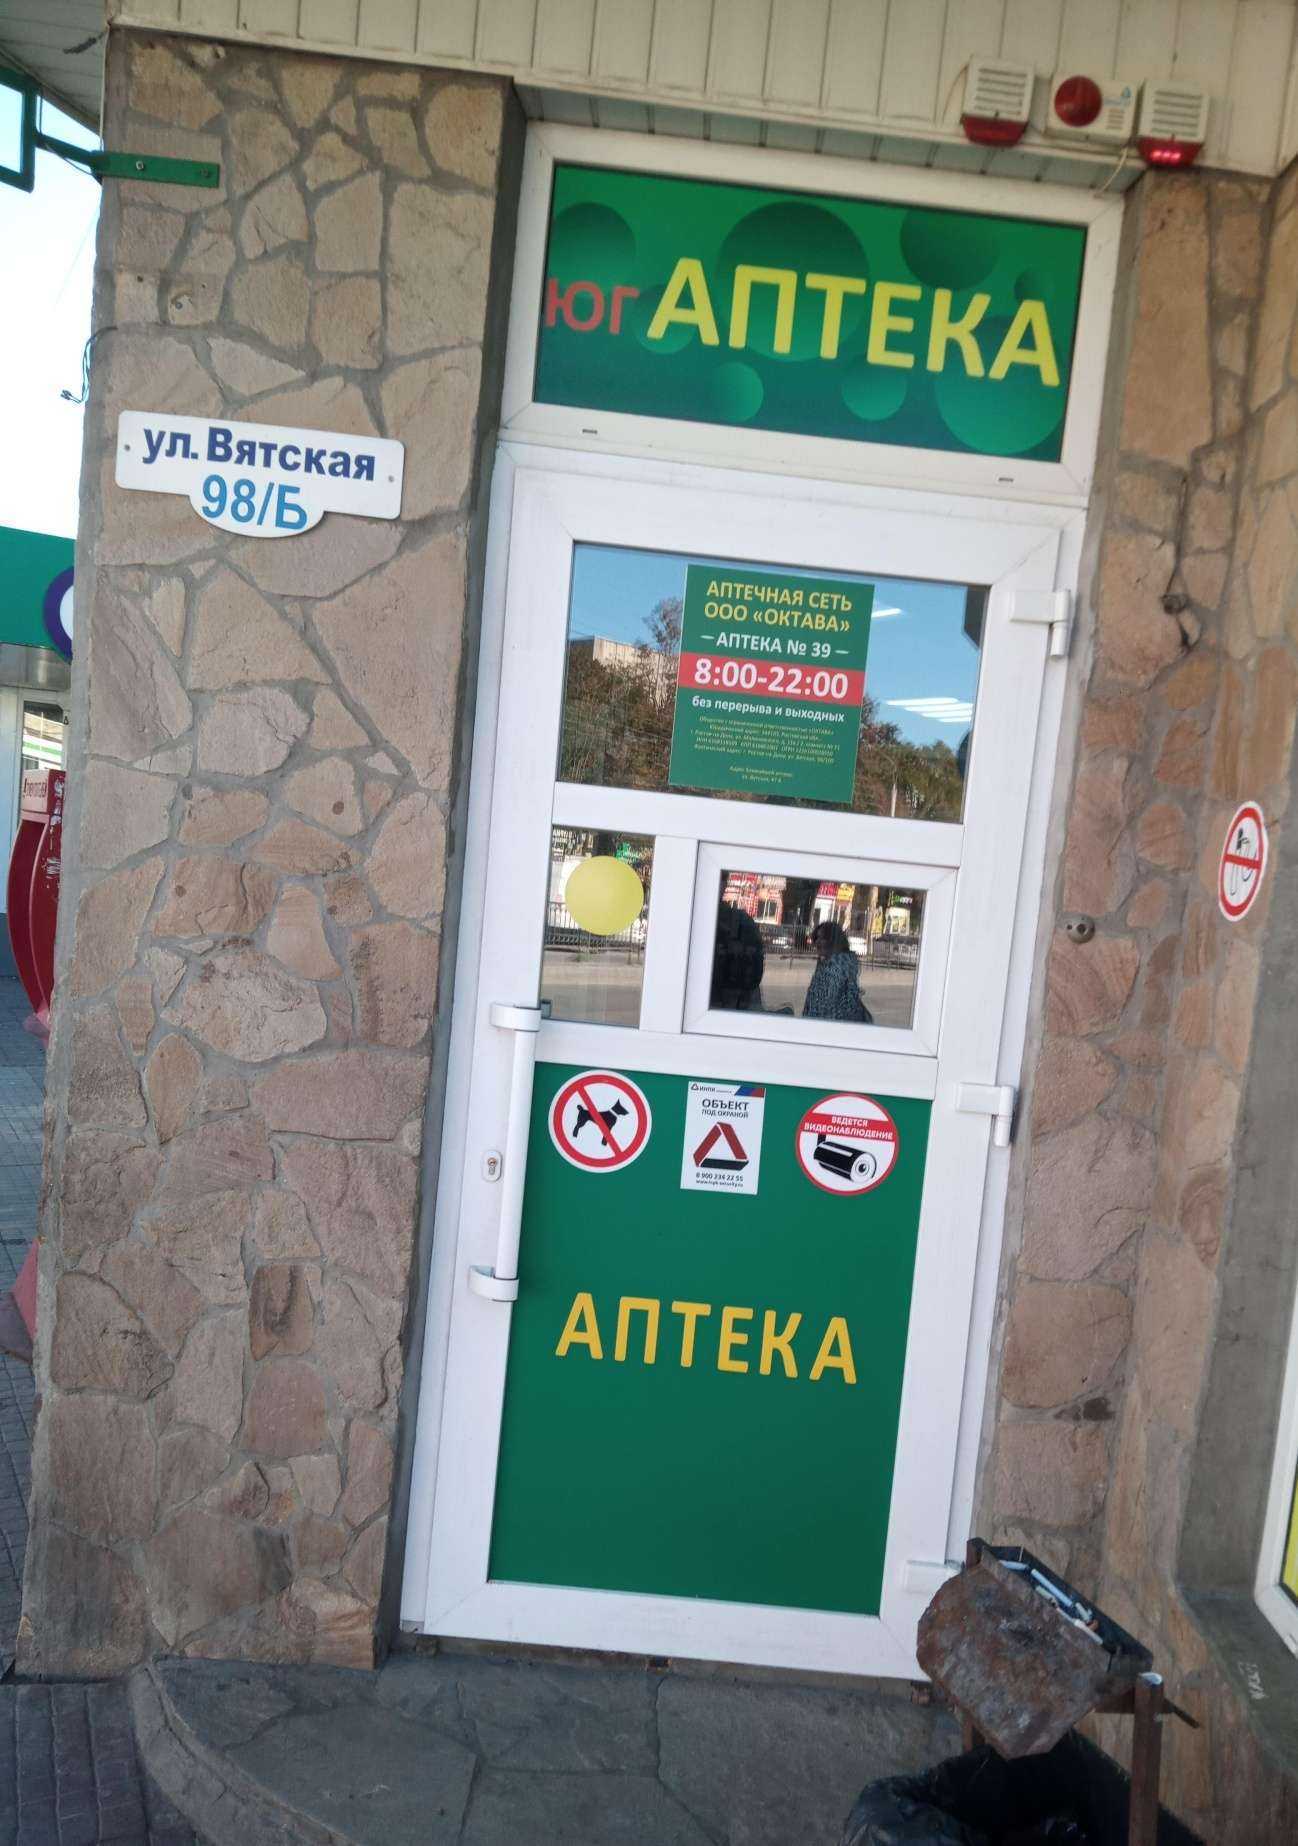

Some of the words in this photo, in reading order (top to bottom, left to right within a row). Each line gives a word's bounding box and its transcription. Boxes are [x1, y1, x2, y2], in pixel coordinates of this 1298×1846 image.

[647, 257, 1061, 387] АПТЕКА
[142, 428, 198, 464] ул.
[207, 427, 376, 481] Вятская
[202, 474, 308, 531] 98/Б
[706, 580, 804, 605] АПТЕЧНАЯ
[809, 591, 853, 612] СЕТЬ
[704, 602, 748, 622] ООО
[753, 607, 851, 632] «ОКТАВА»
[716, 632, 782, 653] АПТЕКА
[787, 639, 807, 656] №
[811, 642, 831, 658] 39
[694, 658, 849, 699] 8:00-22:00
[691, 695, 712, 708] без
[714, 700, 772, 715] перерыва
[775, 707, 783, 716] и
[785, 708, 845, 723] выходных
[701, 1109, 717, 1117] ПОД
[702, 1098, 750, 1111] ОБЪЕКТ
[803, 1122, 893, 1140] ВИДЕОНАБЛЮДЕНИЕ
[831, 1116, 868, 1127] ВЕДЕТСЯ
[554, 1292, 857, 1384] АПТЕКА
